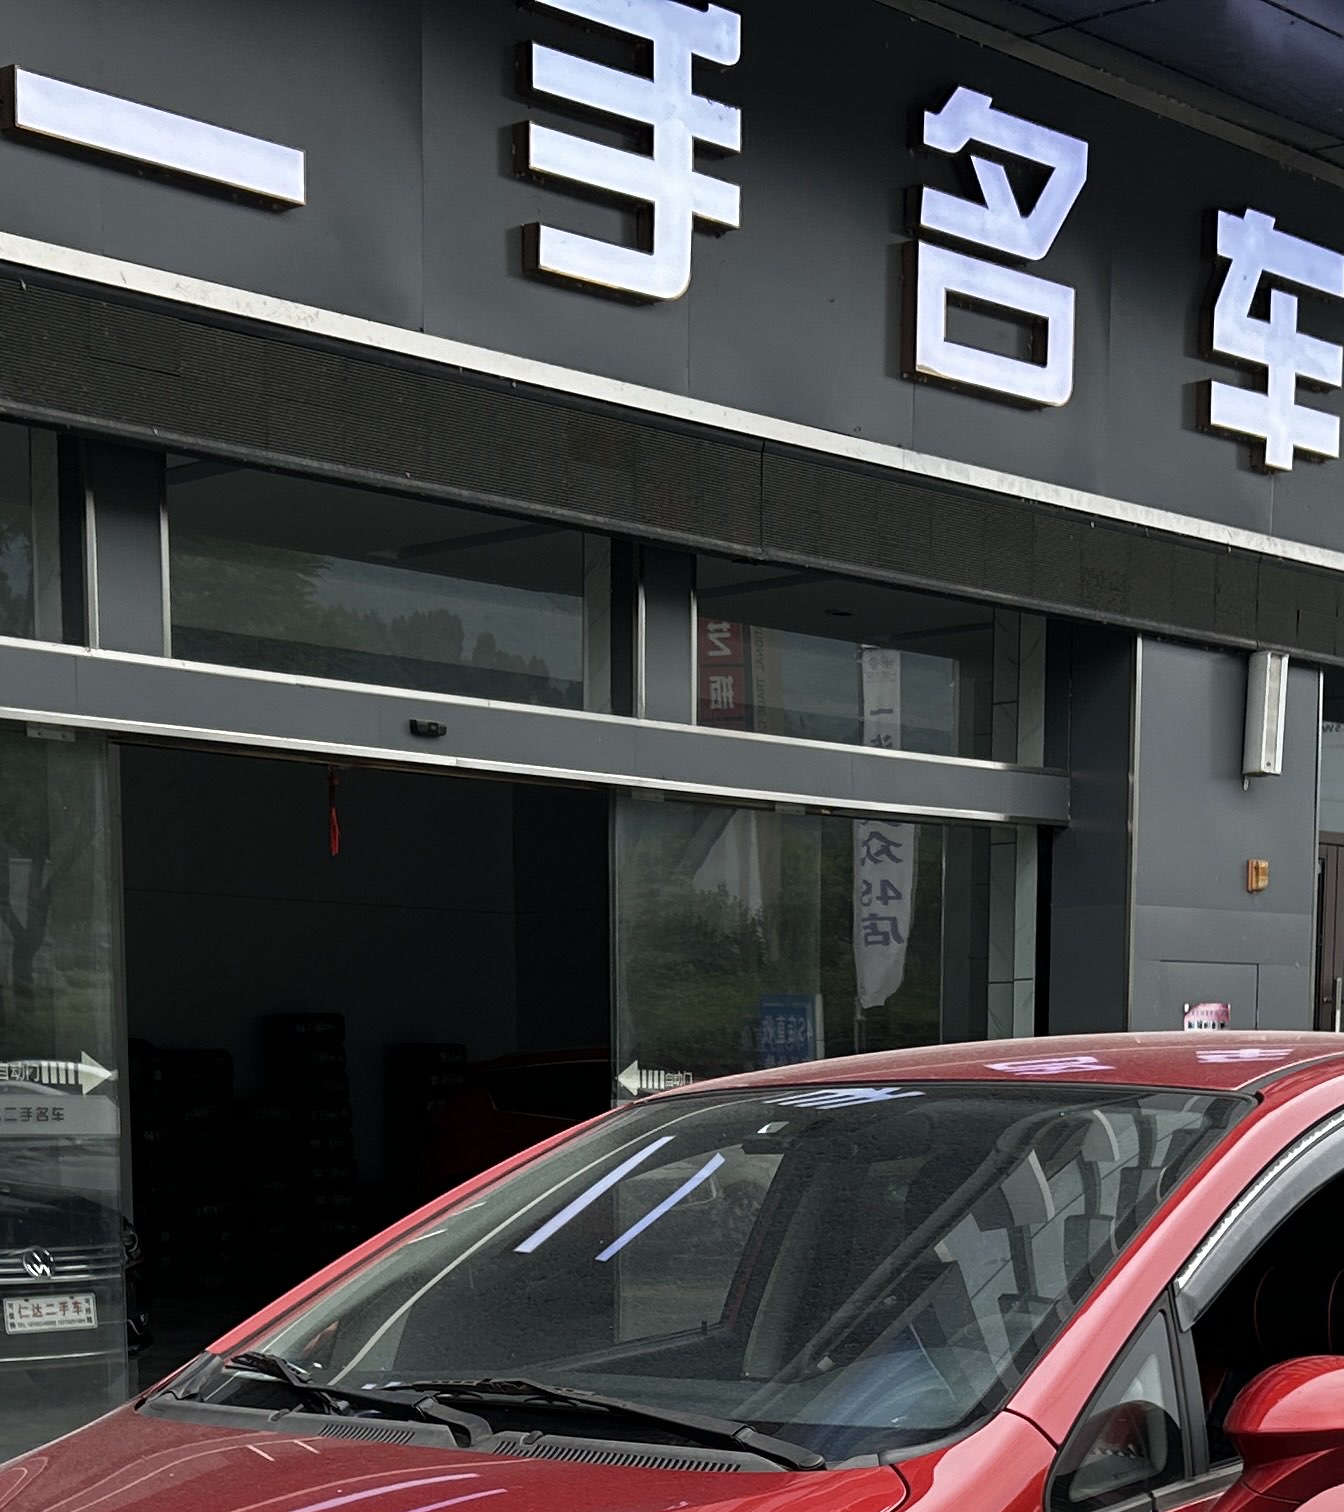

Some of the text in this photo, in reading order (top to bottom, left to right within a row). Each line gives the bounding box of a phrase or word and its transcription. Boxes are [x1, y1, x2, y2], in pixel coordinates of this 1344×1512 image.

[17, 1300, 83, 1319] 仁达二手车
